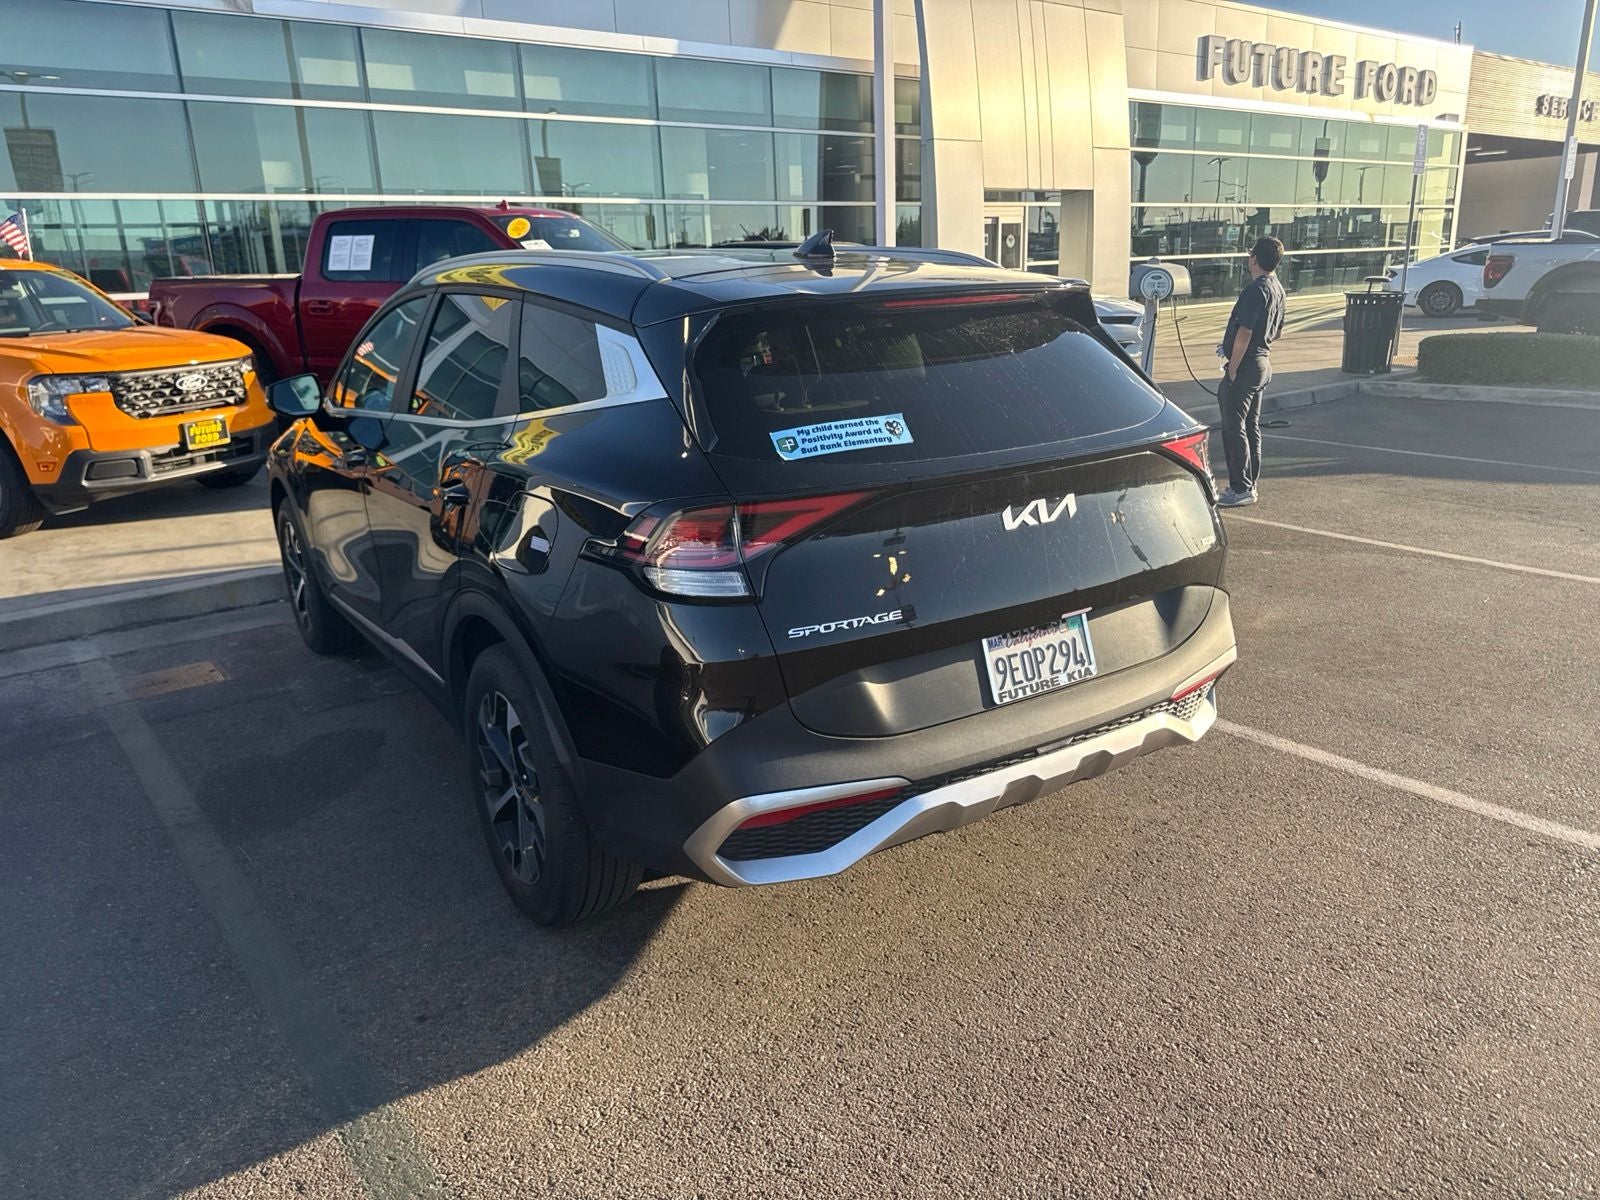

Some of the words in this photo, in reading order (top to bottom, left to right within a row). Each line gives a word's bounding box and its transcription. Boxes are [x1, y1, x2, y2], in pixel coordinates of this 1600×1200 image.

[1196, 35, 1347, 97] FUTURE
[1354, 59, 1438, 107] FORD
[797, 429, 810, 437] My
[812, 425, 832, 433] child
[835, 421, 863, 429] earned
[802, 431, 843, 443] Positivity
[845, 429, 869, 437] Award
[802, 446, 818, 454] Bud
[845, 436, 892, 447] Elementary
[1001, 493, 1077, 531] KIA
[788, 609, 903, 638] SPORTAGE
[987, 636, 1003, 649] MAR
[994, 636, 1087, 691] 9EOP294
[998, 676, 1060, 703] FUTURE
[1067, 667, 1093, 681] KIA
